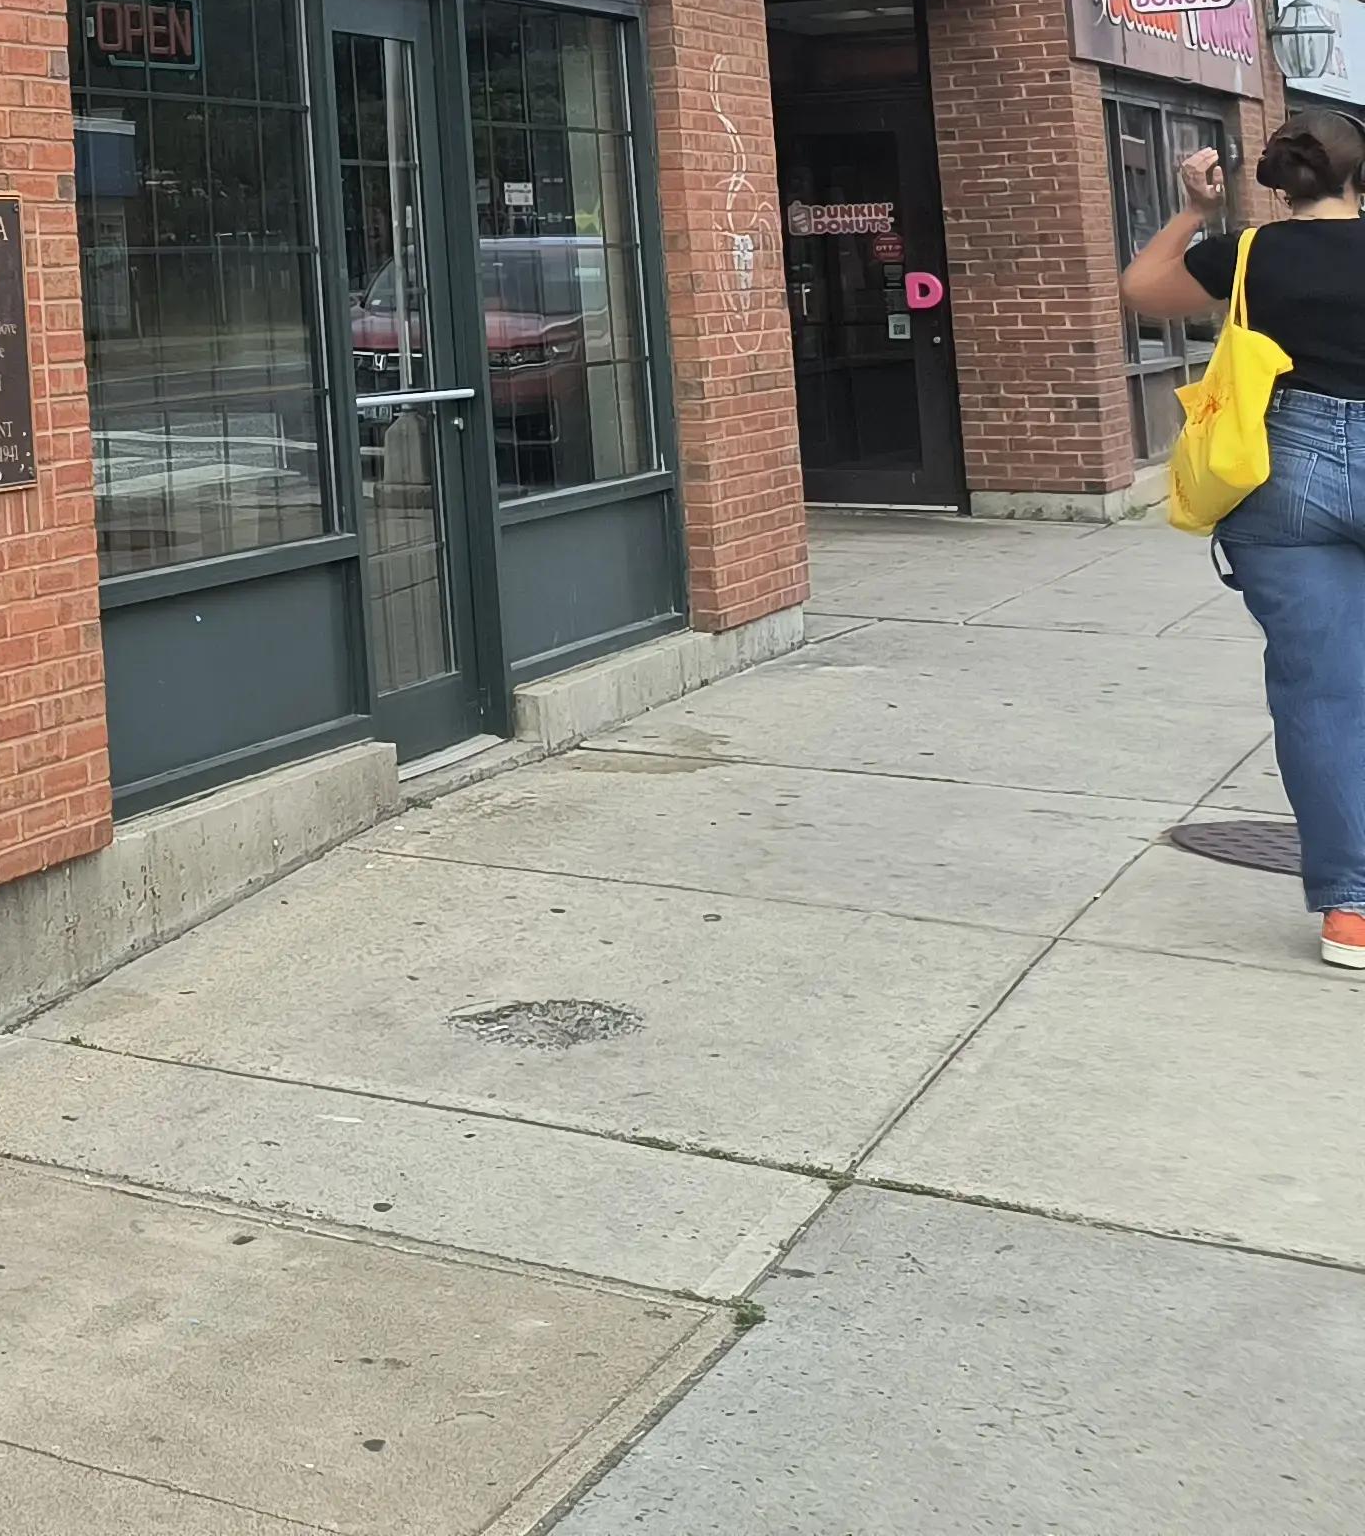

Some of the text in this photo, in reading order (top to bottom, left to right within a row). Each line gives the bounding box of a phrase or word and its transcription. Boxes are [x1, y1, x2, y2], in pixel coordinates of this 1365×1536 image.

[96, 1, 193, 56] OPEN
[812, 203, 894, 220] DUNKIN'
[813, 217, 891, 235] DONUTS
[905, 272, 944, 309] D
[0, 444, 20, 463] 1941
